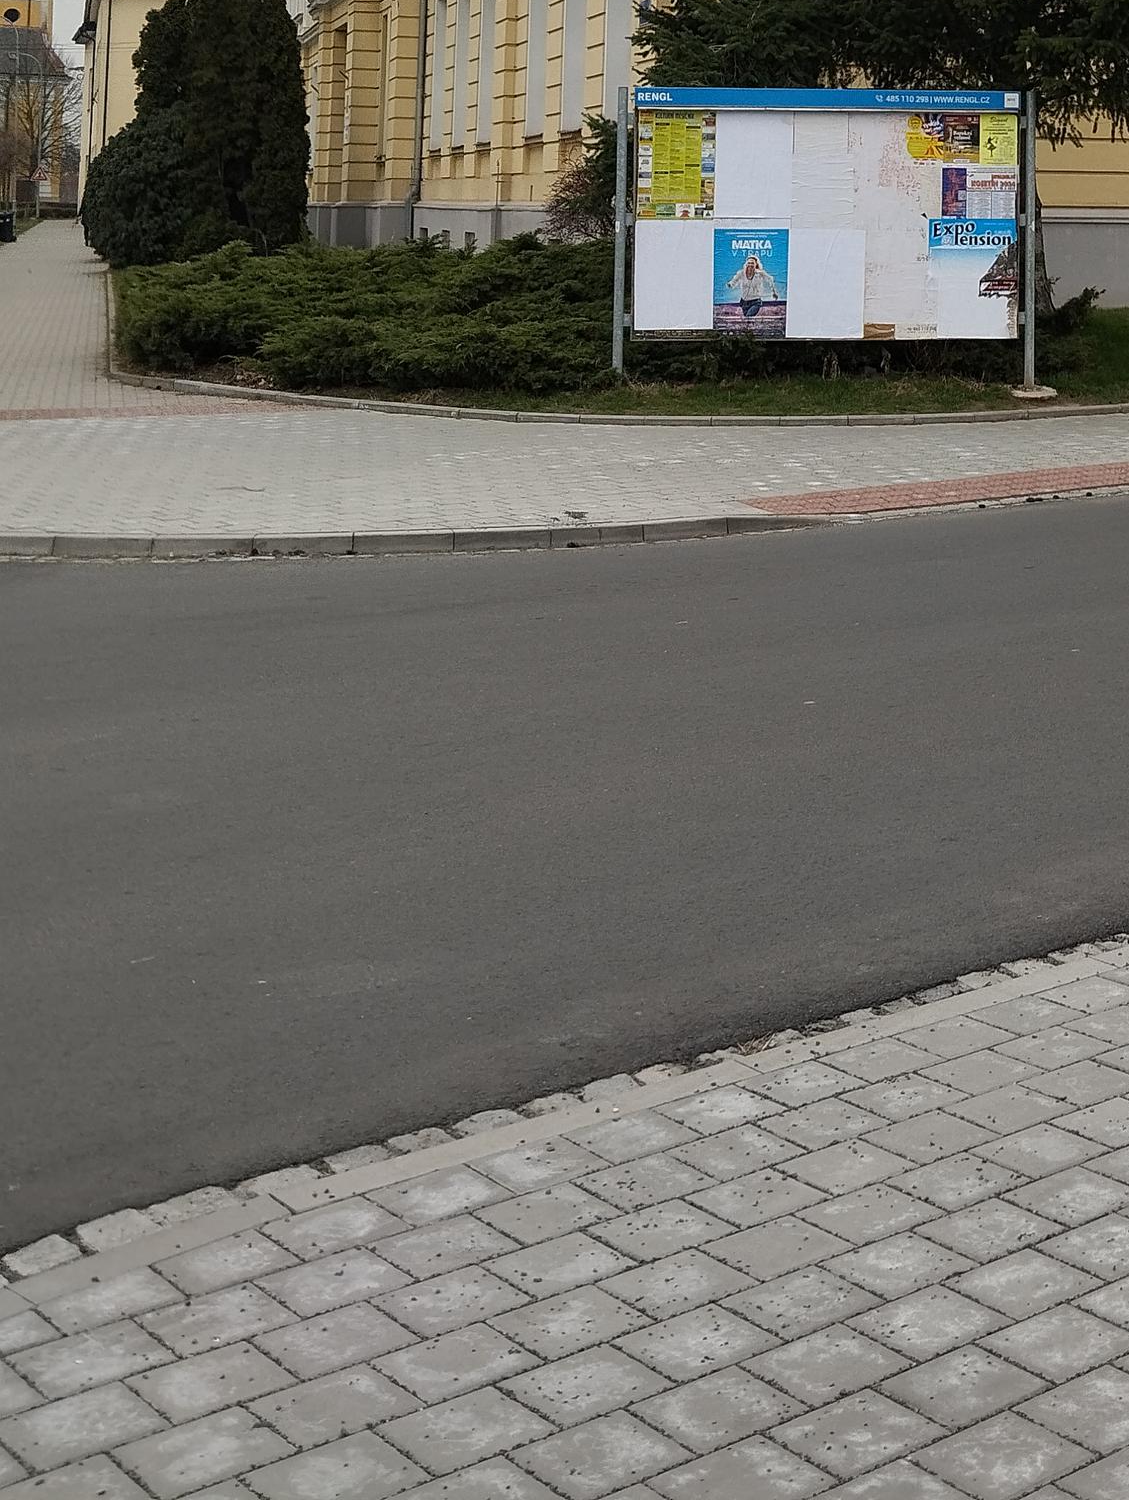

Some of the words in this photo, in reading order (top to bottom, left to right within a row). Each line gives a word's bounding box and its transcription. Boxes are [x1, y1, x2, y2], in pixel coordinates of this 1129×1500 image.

[637, 92, 673, 101] RENGL
[885, 95, 899, 103] 485
[901, 95, 914, 103] 110
[933, 96, 990, 104] WWW.RENGL.CZ
[933, 222, 975, 245] Expo
[731, 240, 772, 249] MATKA
